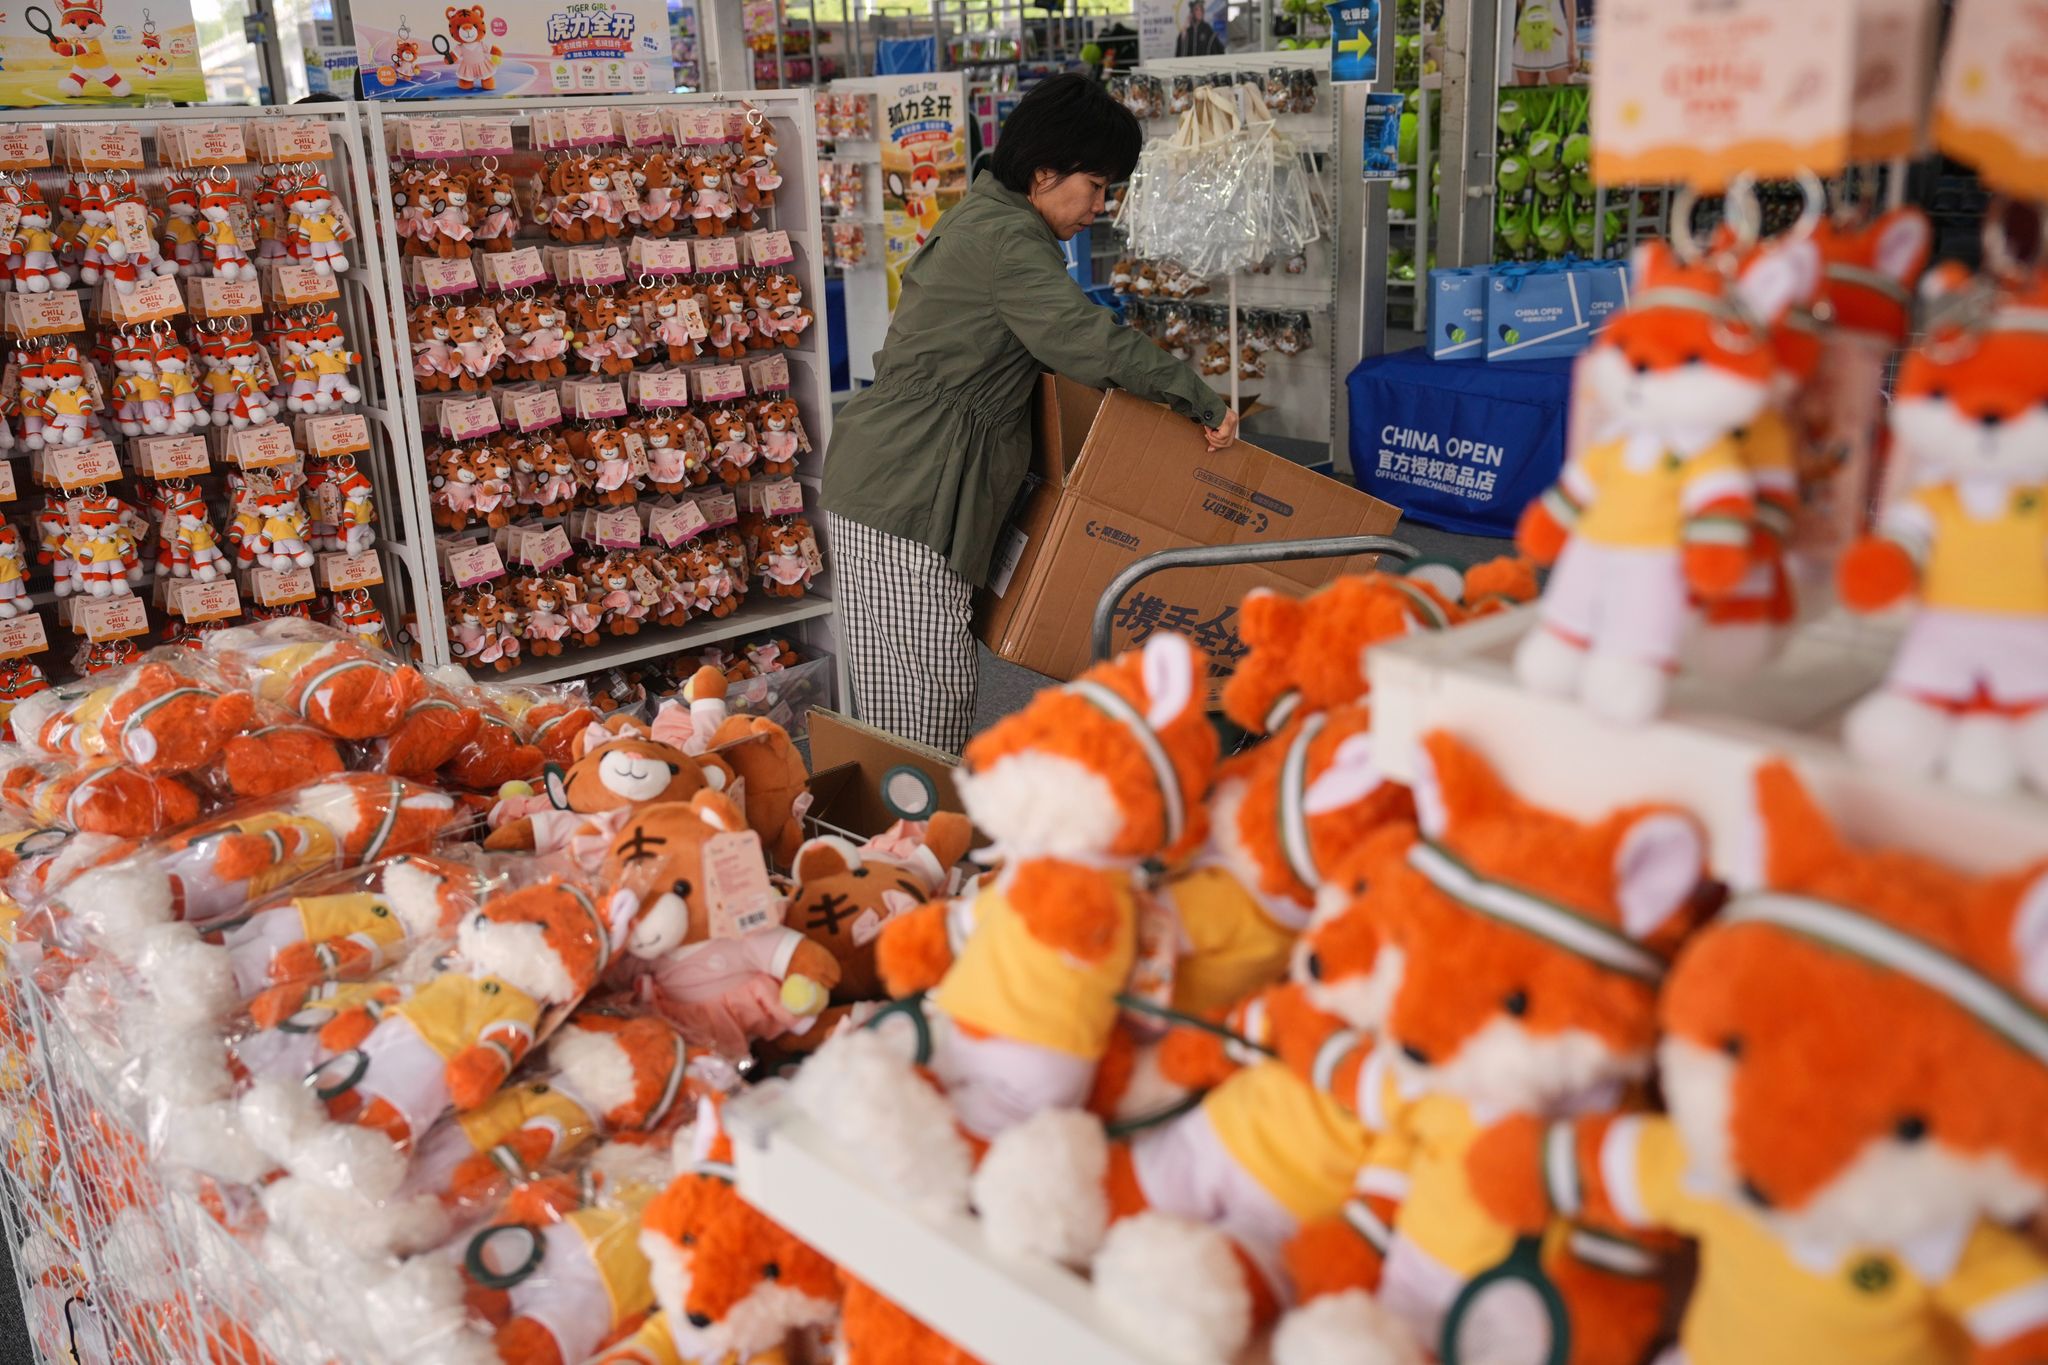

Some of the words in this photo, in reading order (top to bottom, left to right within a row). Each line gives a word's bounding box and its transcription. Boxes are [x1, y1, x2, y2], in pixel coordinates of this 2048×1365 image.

[567, 3, 589, 13] TIGER
[592, 2, 608, 10] GIRL
[1341, 8, 1369, 21] 收银台
[547, 11, 634, 43] 虎力全开
[899, 85, 920, 98] CHILL
[923, 81, 937, 91] FOX
[888, 95, 952, 128] 狐力全开
[140, 294, 163, 304] CHILL
[1464, 308, 1482, 316] CHIN
[1515, 308, 1539, 317] CHINA
[1541, 307, 1563, 315] OPEN
[332, 432, 352, 440] CHILL
[1381, 424, 1440, 454] CHINA
[1446, 437, 1504, 467] OPEN
[77, 462, 101, 470] CHILL
[1378, 449, 1497, 492] 官方授权商品店
[1375, 469, 1411, 484] OFFICIAL
[1412, 477, 1465, 497] MERCHANDISE
[1467, 488, 1493, 501] SHOP
[346, 567, 366, 575] CHILL
[201, 597, 223, 606] CHILL
[106, 616, 130, 625] CHILL
[3, 633, 28, 643] CHILL
